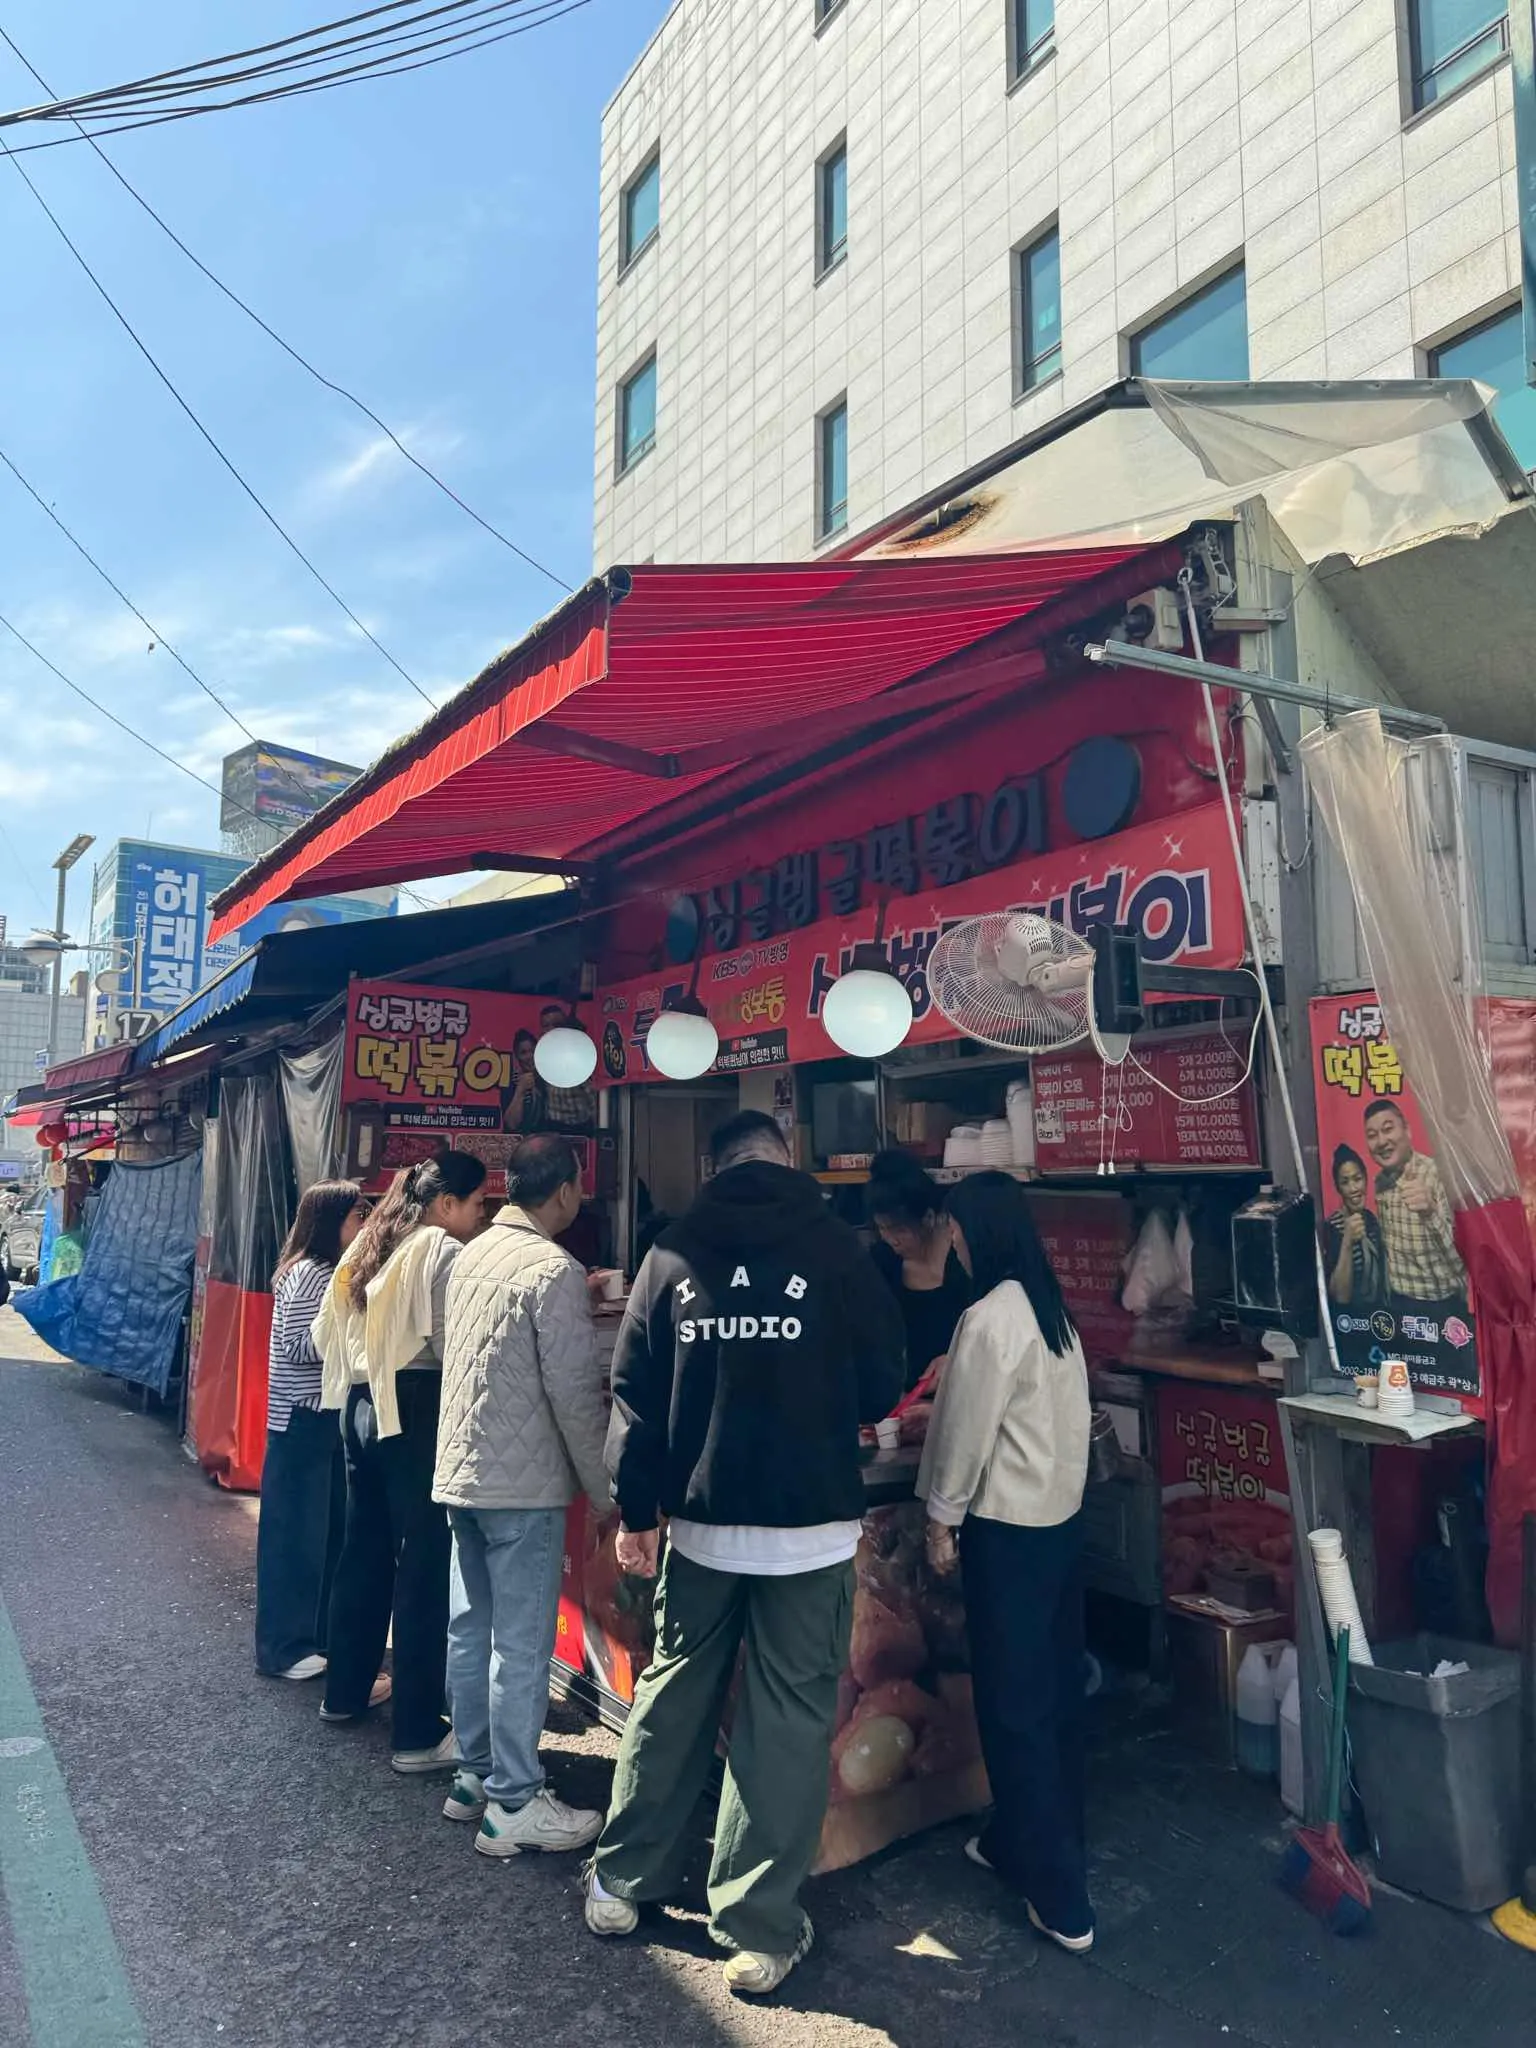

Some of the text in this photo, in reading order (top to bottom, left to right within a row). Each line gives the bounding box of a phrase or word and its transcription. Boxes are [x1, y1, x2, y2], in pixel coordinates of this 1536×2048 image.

[148, 868, 200, 1005] 허태정
[711, 957, 738, 980] KBS
[118, 1012, 152, 1042] 17
[356, 992, 470, 1035] 싱글벙글
[1338, 1004, 1384, 1040] 싱글
[356, 1035, 513, 1098] 떡볶이
[1322, 1040, 1404, 1097] 떡볶
[679, 1314, 802, 1344] STUDIO
[1401, 1315, 1439, 1344] 투데이
[1419, 1372, 1447, 1386] 예금주
[1174, 1408, 1272, 1468] 싱글벙글
[1185, 1455, 1267, 1503] 떡볶이
